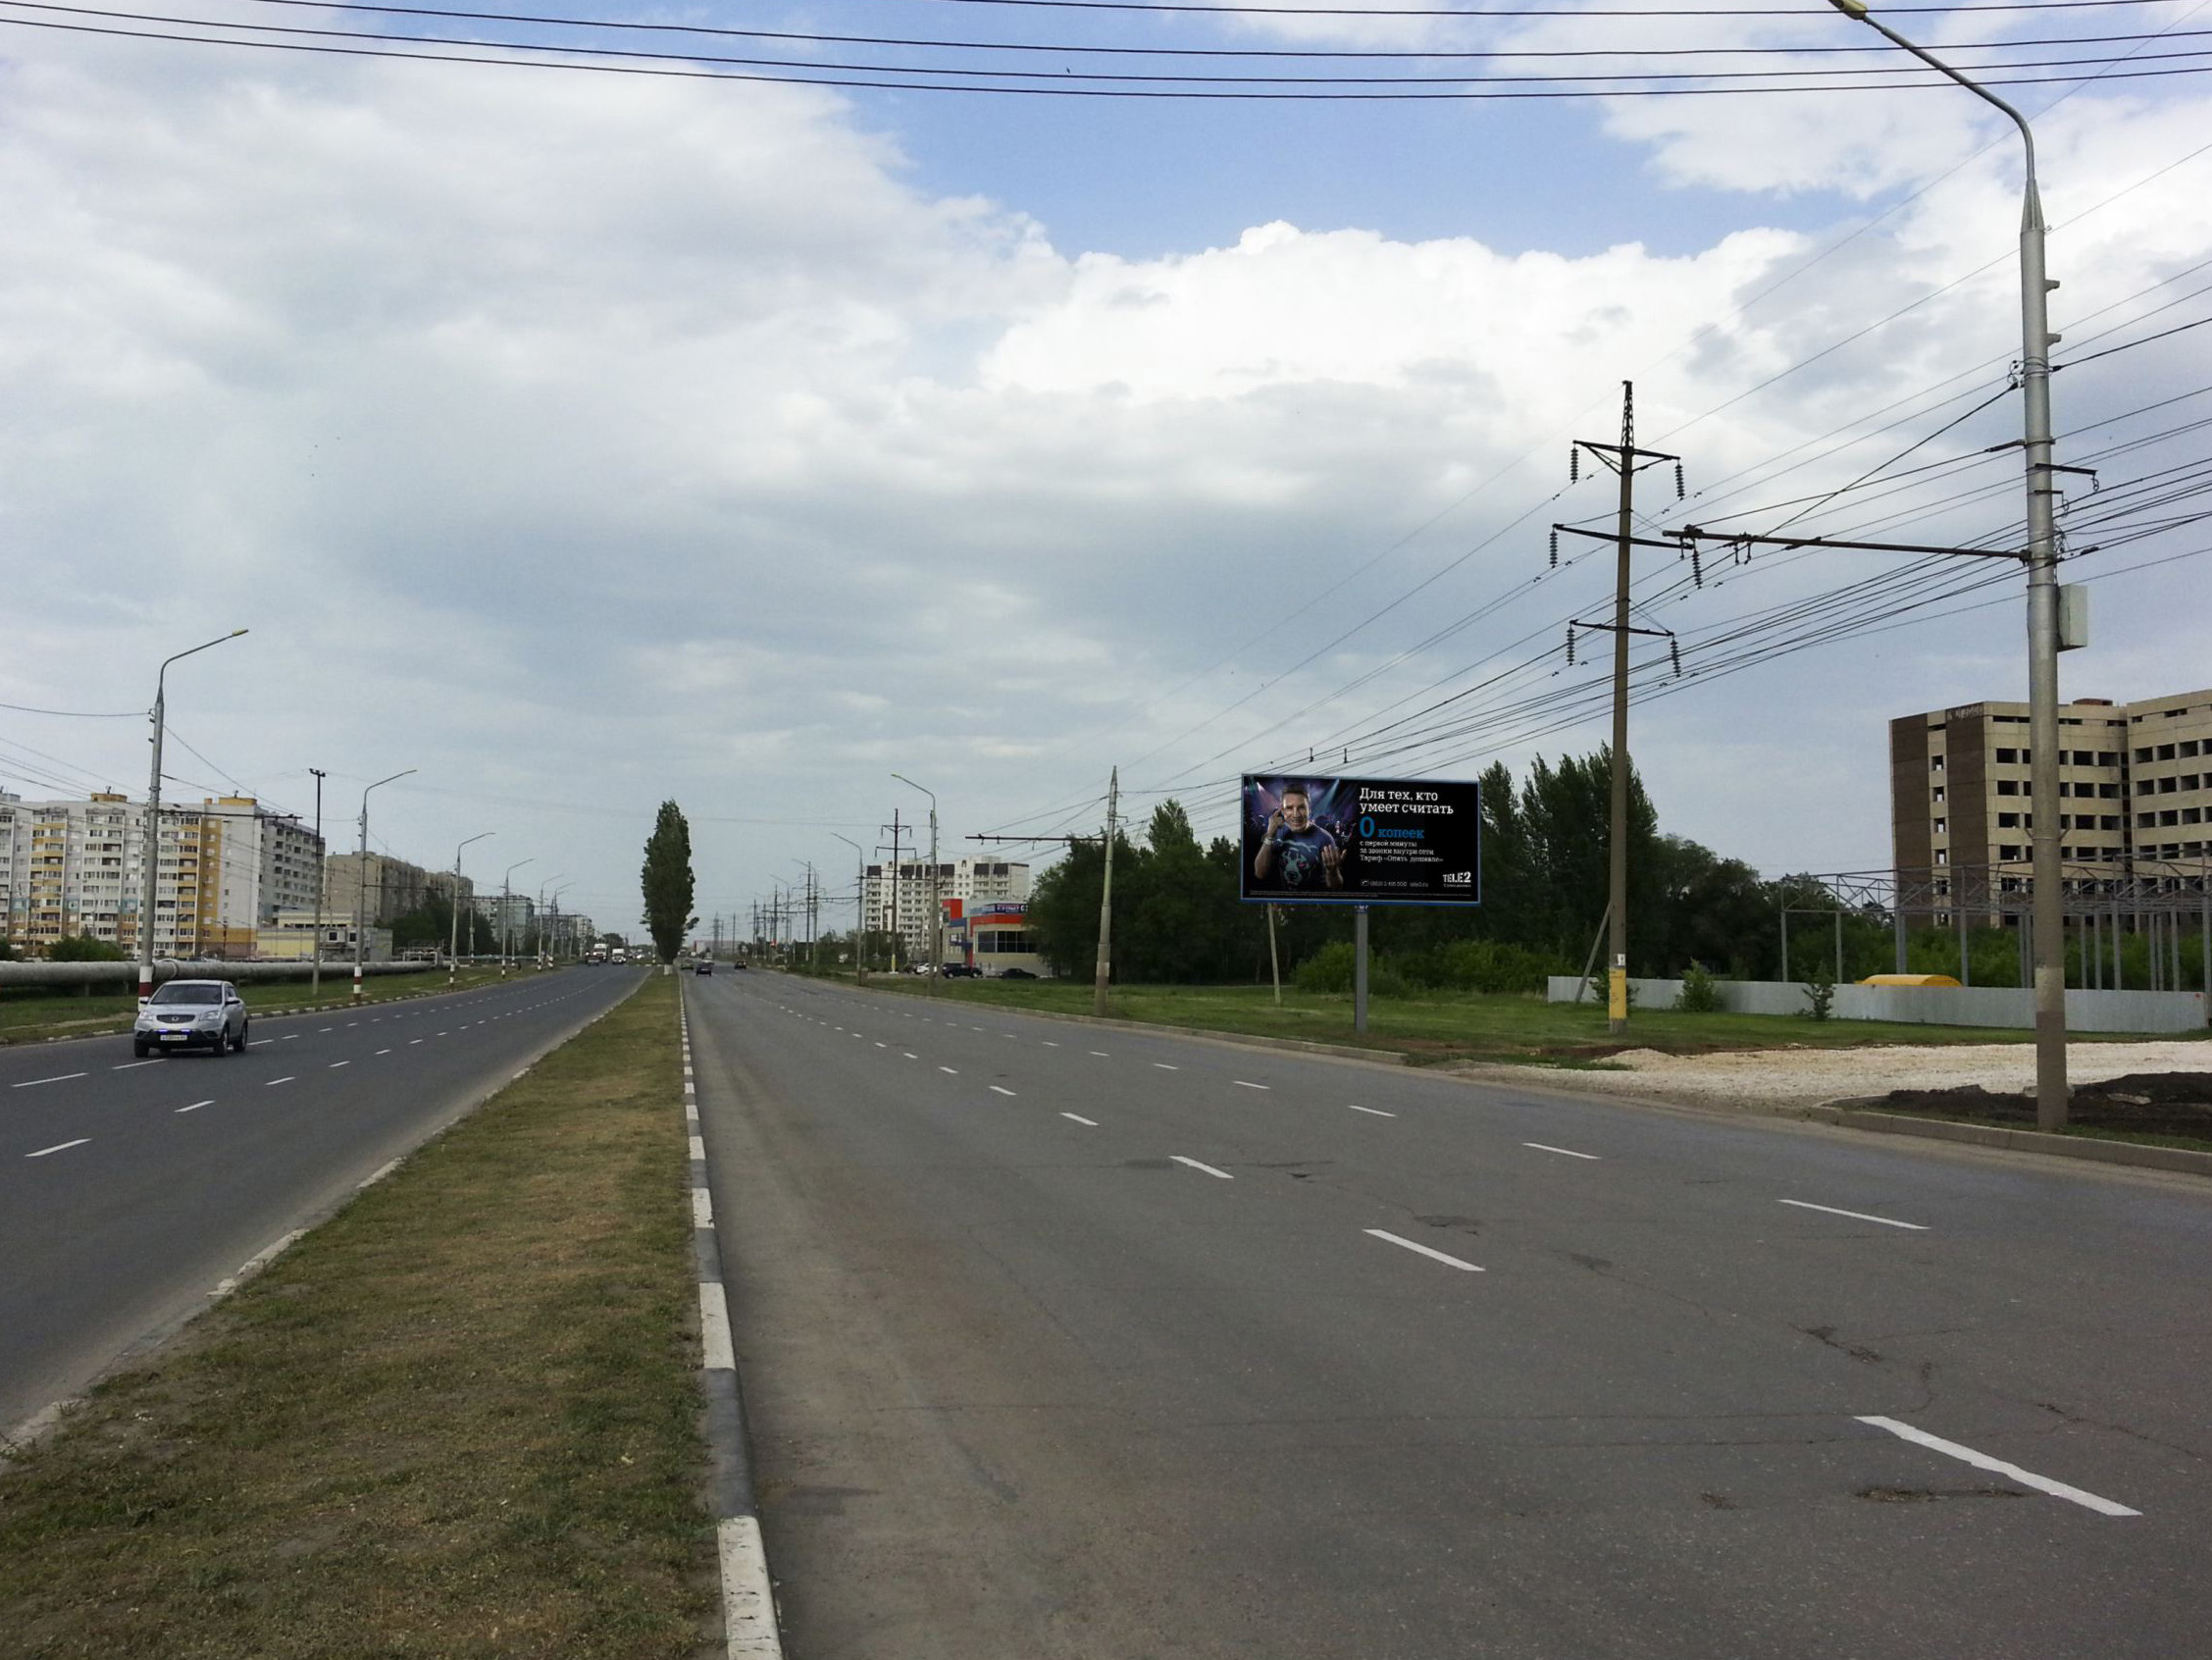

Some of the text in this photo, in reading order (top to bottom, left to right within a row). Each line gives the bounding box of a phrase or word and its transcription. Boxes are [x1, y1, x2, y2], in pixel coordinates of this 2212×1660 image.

[1360, 788, 1438, 802] Для тех, кто
[1360, 803, 1454, 814] умеет считать
[1360, 816, 1425, 839] 0 копеек
[1443, 871, 1471, 882] TELE2
